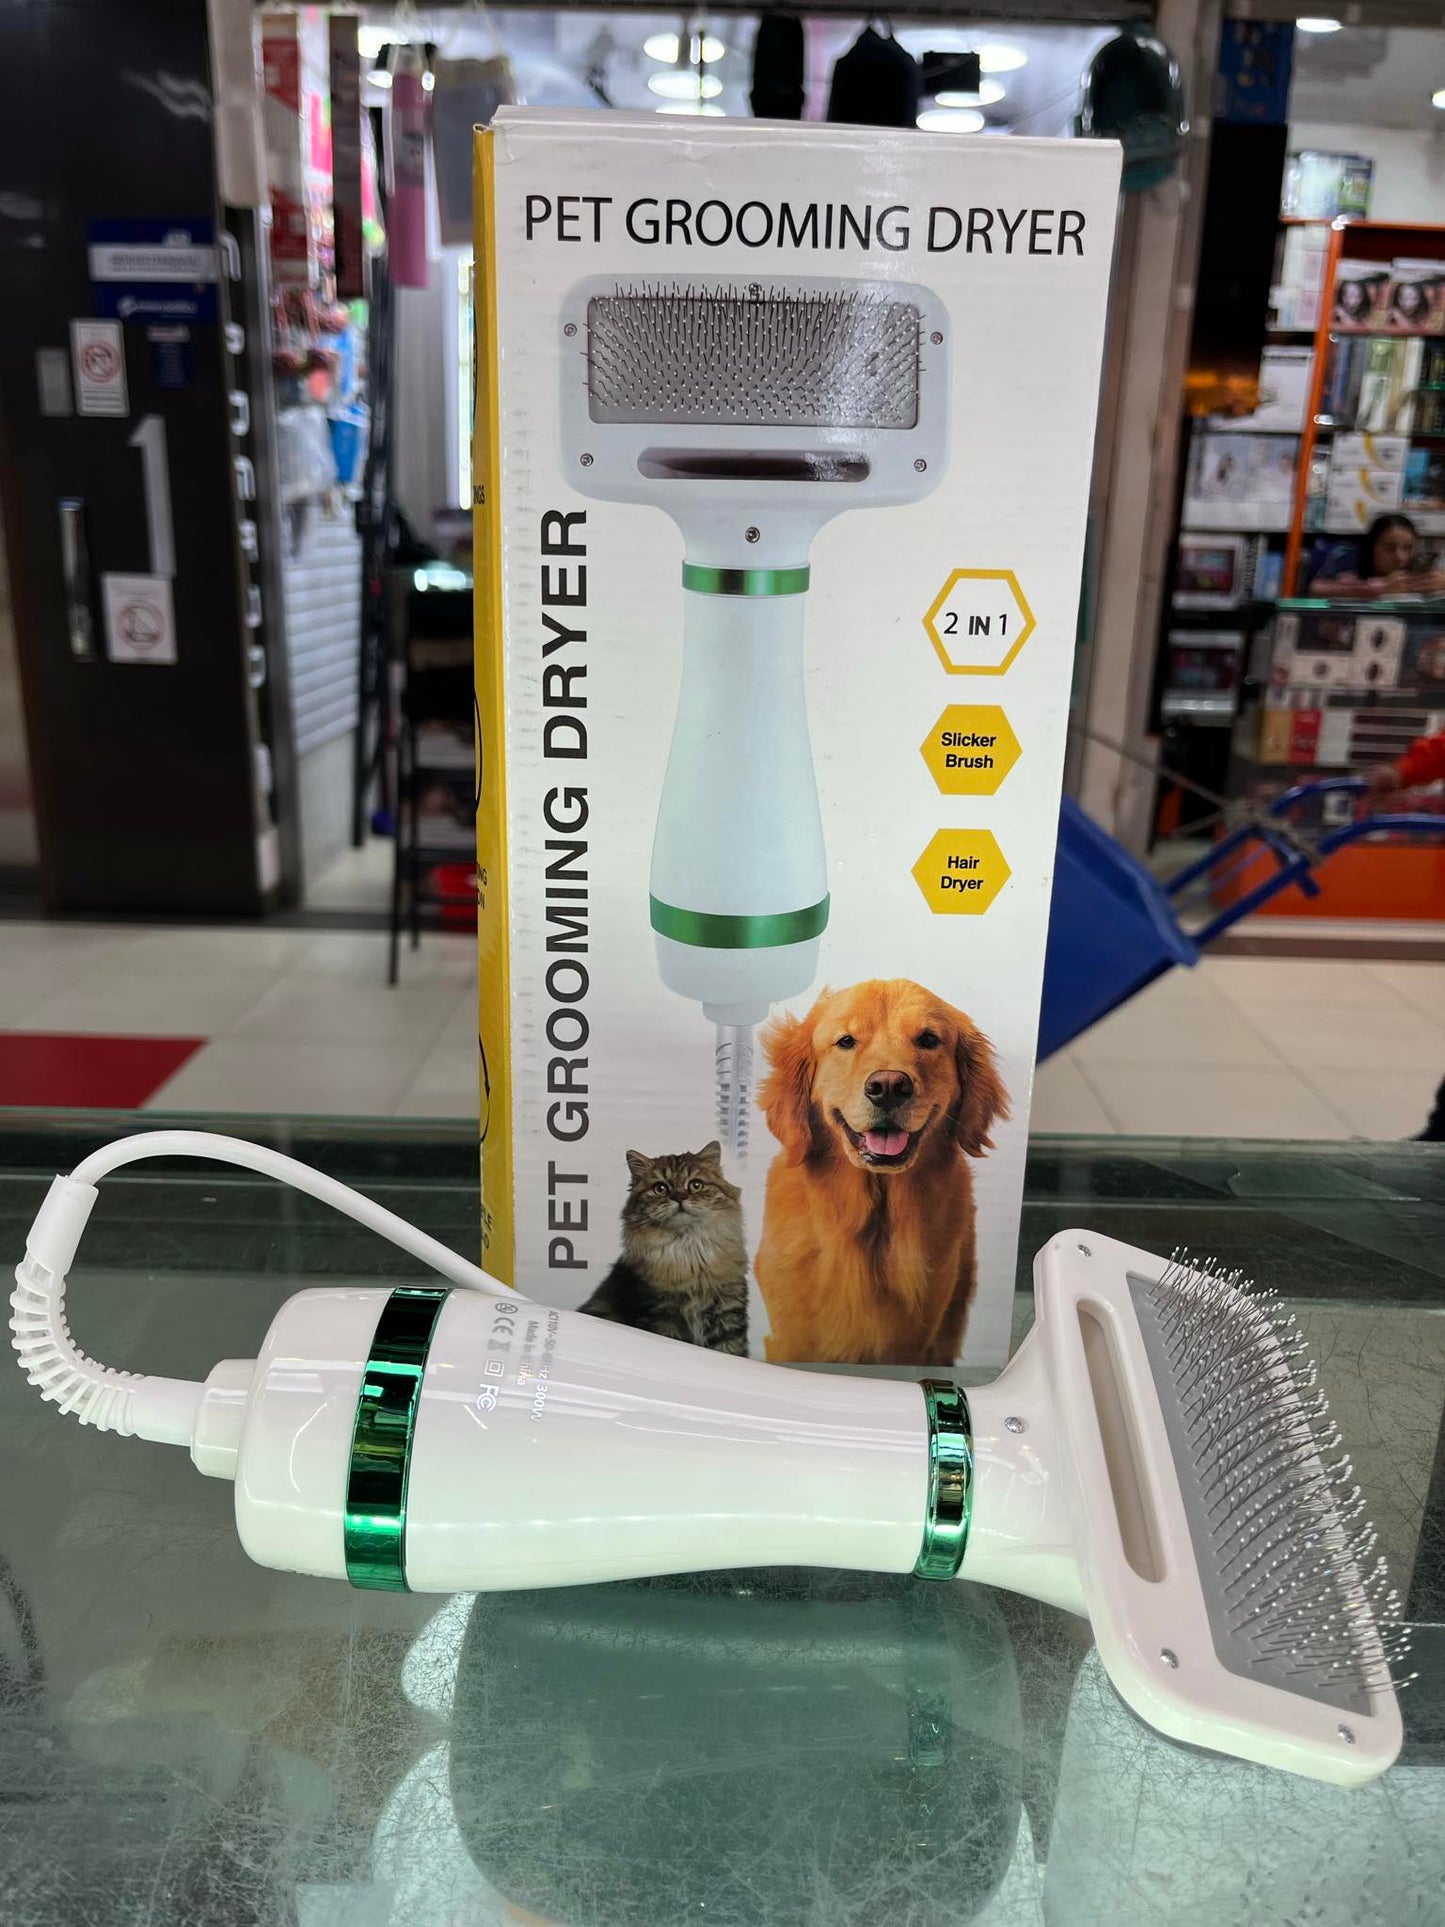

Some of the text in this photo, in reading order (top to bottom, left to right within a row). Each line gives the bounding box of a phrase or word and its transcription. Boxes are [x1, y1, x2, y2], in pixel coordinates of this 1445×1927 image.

[525, 194, 1086, 256] PET GROOMING DRYER
[943, 611, 1007, 636] 2 IN 1
[941, 731, 997, 748] Slicker
[945, 753, 994, 769] Brush
[947, 855, 980, 870] Hair
[540, 509, 590, 1270] PET GROOMING DRYER
[940, 875, 984, 893] Dryer
